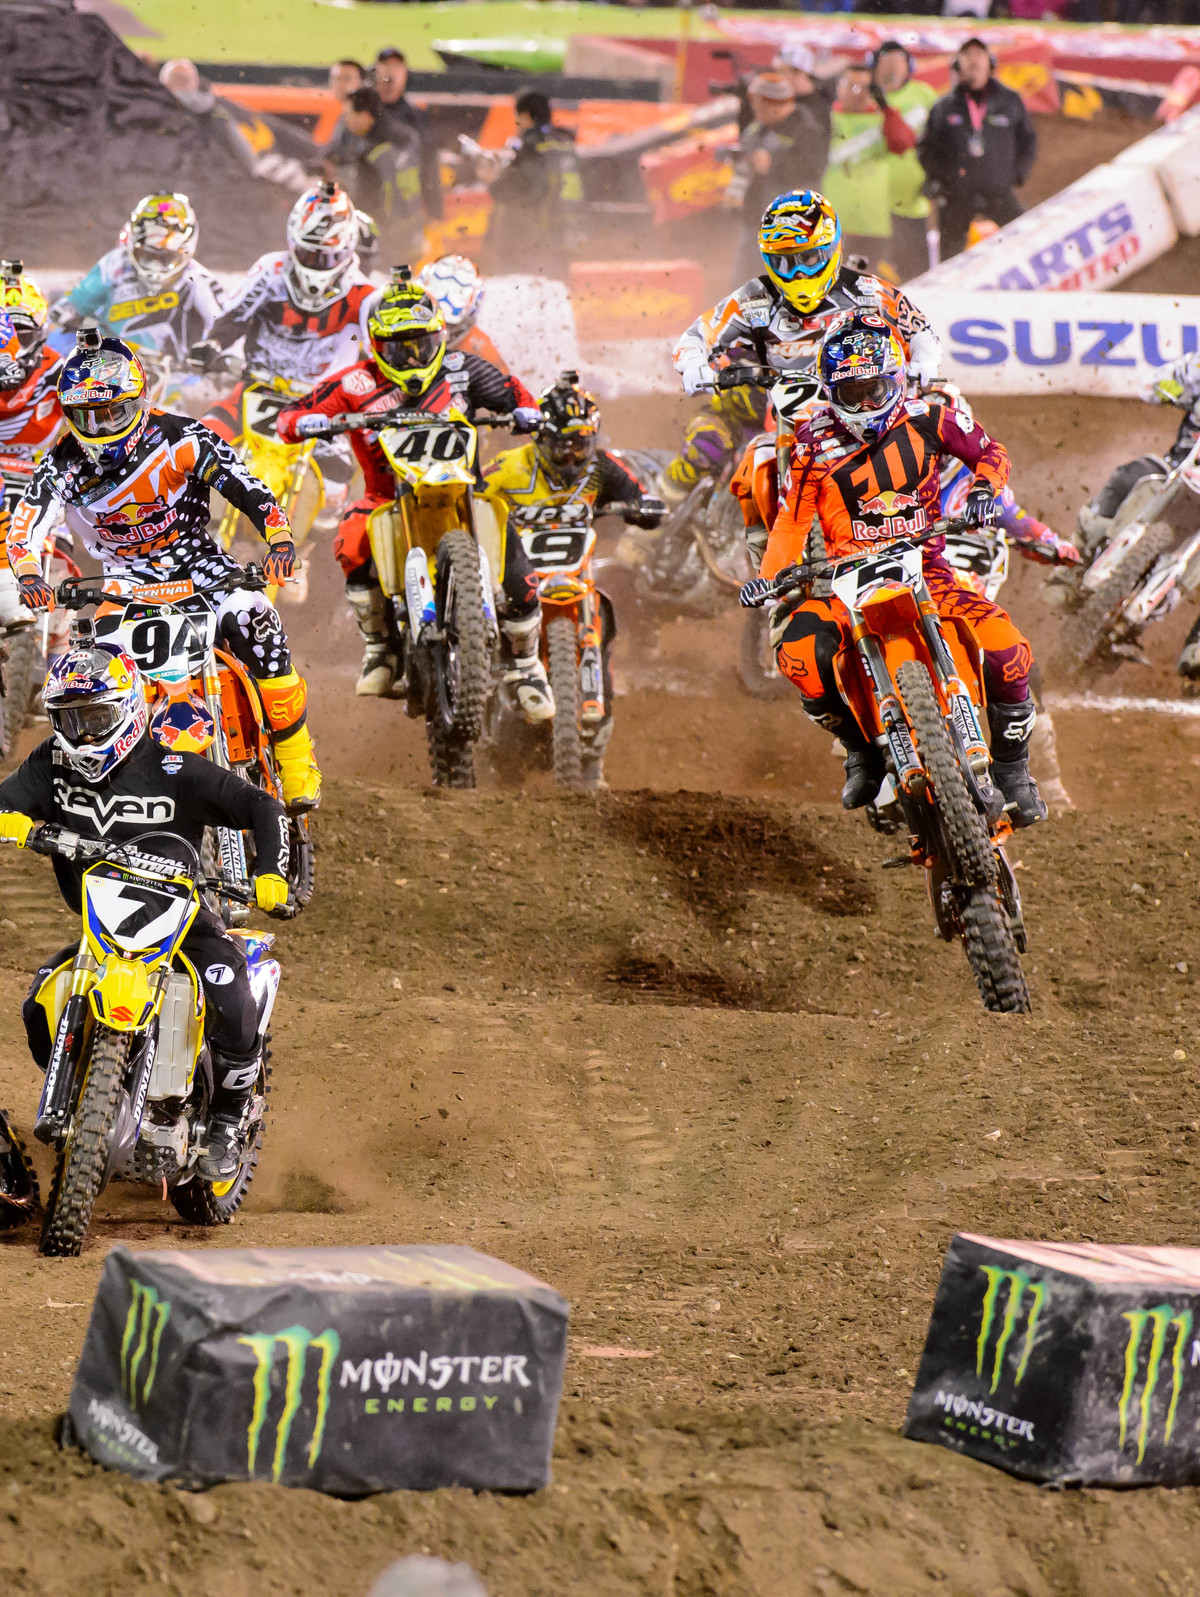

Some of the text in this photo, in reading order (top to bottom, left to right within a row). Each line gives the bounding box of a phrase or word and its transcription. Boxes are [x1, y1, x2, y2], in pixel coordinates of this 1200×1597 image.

[109, 291, 179, 322] GEICO
[950, 319, 1198, 368] SUZU
[832, 366, 879, 380] Red Bull
[66, 389, 113, 402] Red Bull
[394, 430, 471, 462] 40
[97, 508, 178, 543] Red Bull
[853, 508, 926, 541] Red Bull
[528, 532, 586, 567] 9
[132, 614, 208, 671] 94
[66, 681, 94, 689] Bull
[115, 718, 141, 757] Red
[883, 711, 908, 763] DNLOP
[896, 721, 915, 754] ATHENA
[230, 829, 243, 881] DUNLO
[129, 875, 163, 888] MONSTER
[114, 884, 176, 938] 7
[208, 966, 227, 984] 7
[133, 1038, 156, 1122] DUNLOP
[339, 1350, 531, 1394] MONSTER
[364, 1395, 499, 1415] ENERGY
[934, 1389, 1035, 1442] MONSTER
[87, 1398, 159, 1465] MONSTER
[944, 1416, 1018, 1449] ENERGY
